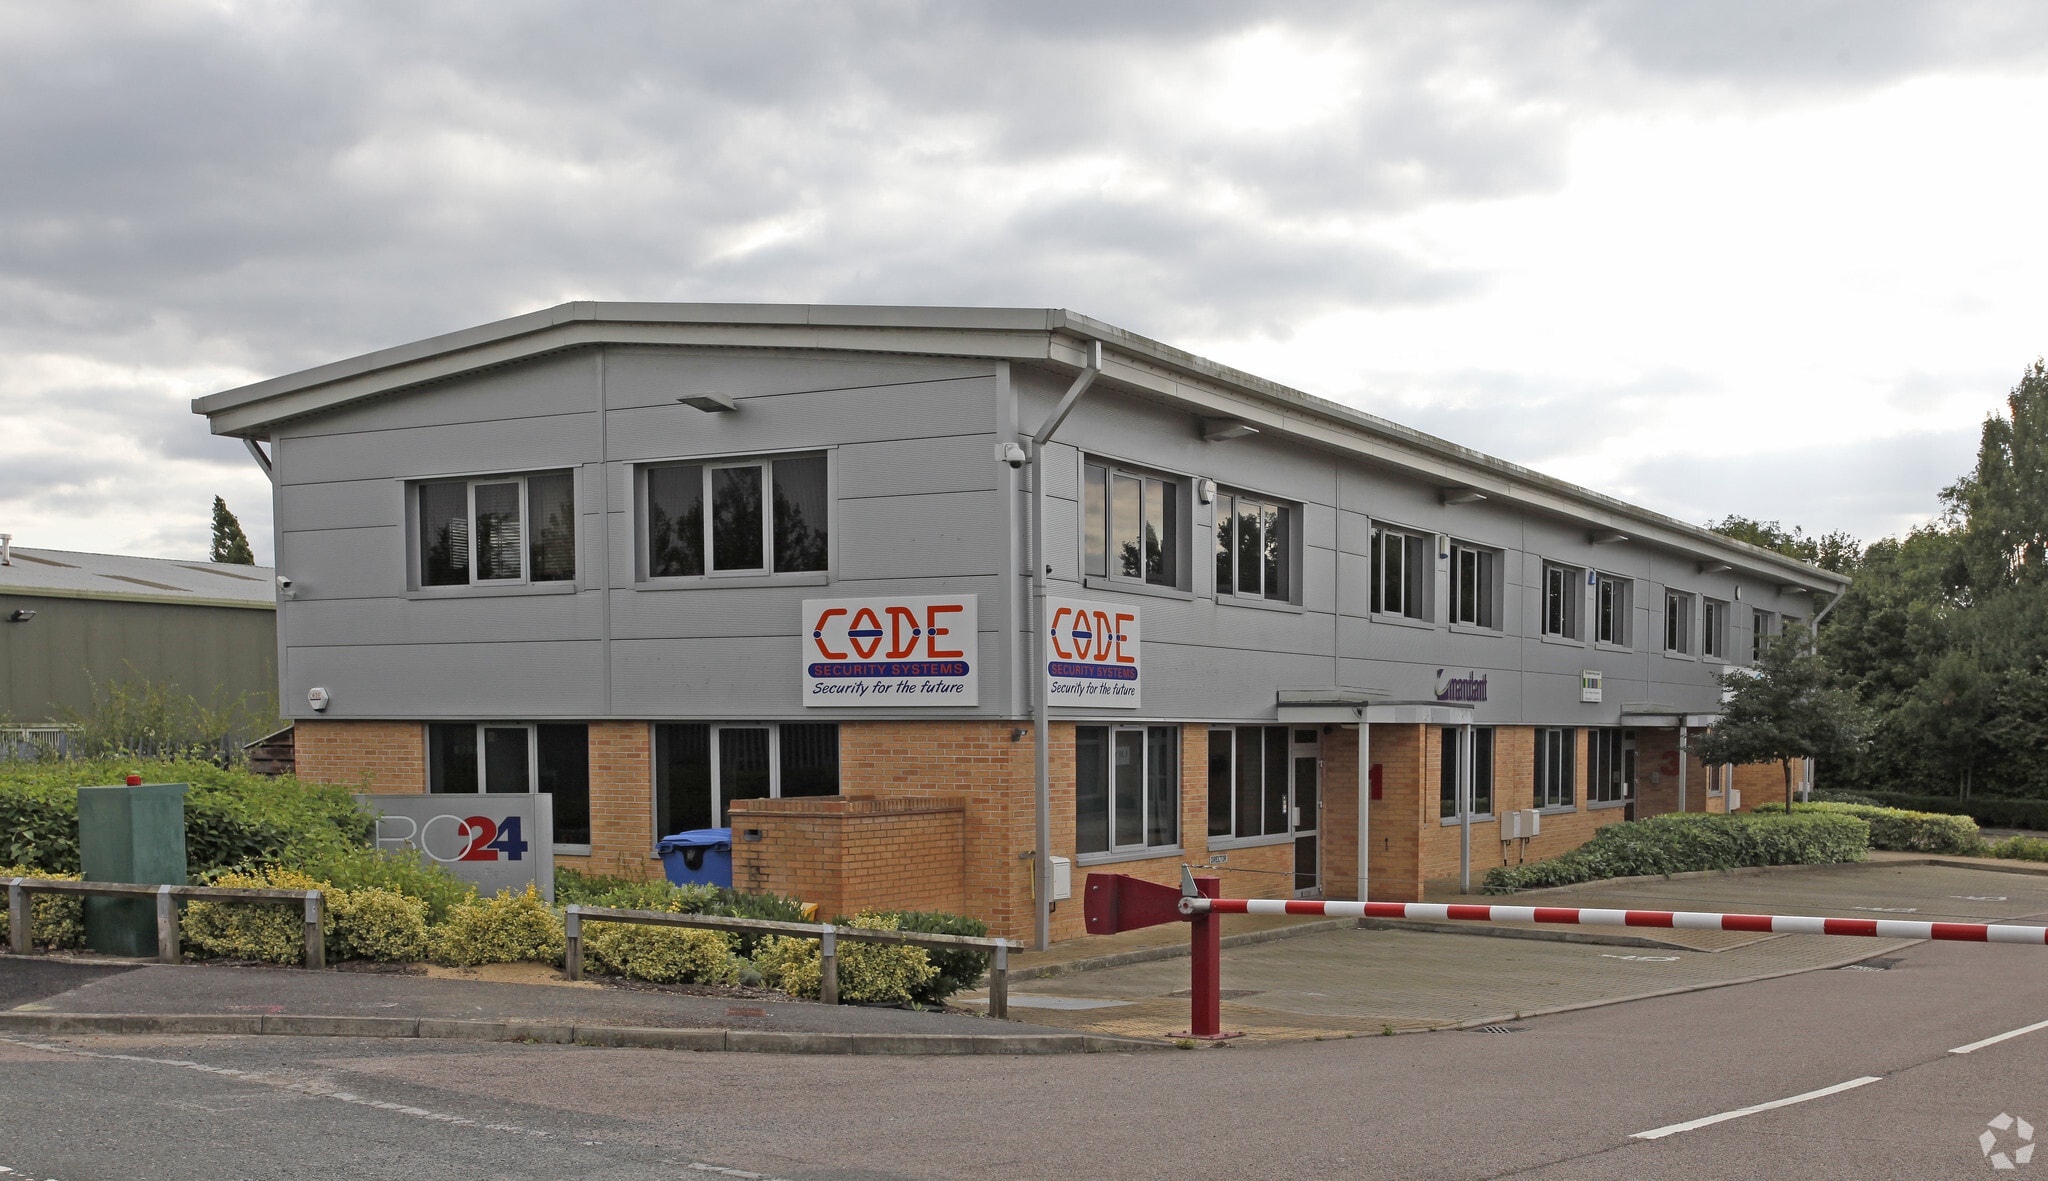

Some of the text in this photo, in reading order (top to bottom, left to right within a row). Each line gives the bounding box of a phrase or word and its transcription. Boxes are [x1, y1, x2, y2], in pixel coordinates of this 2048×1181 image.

[813, 605, 963, 659] CODE
[1051, 607, 1135, 663] CODE
[814, 663, 964, 676] SECURITY SYSTEMS
[1051, 663, 1135, 679] SECURITY SYSTEMS
[812, 680, 964, 697] Security for the future
[1051, 681, 1135, 697] Security for the future
